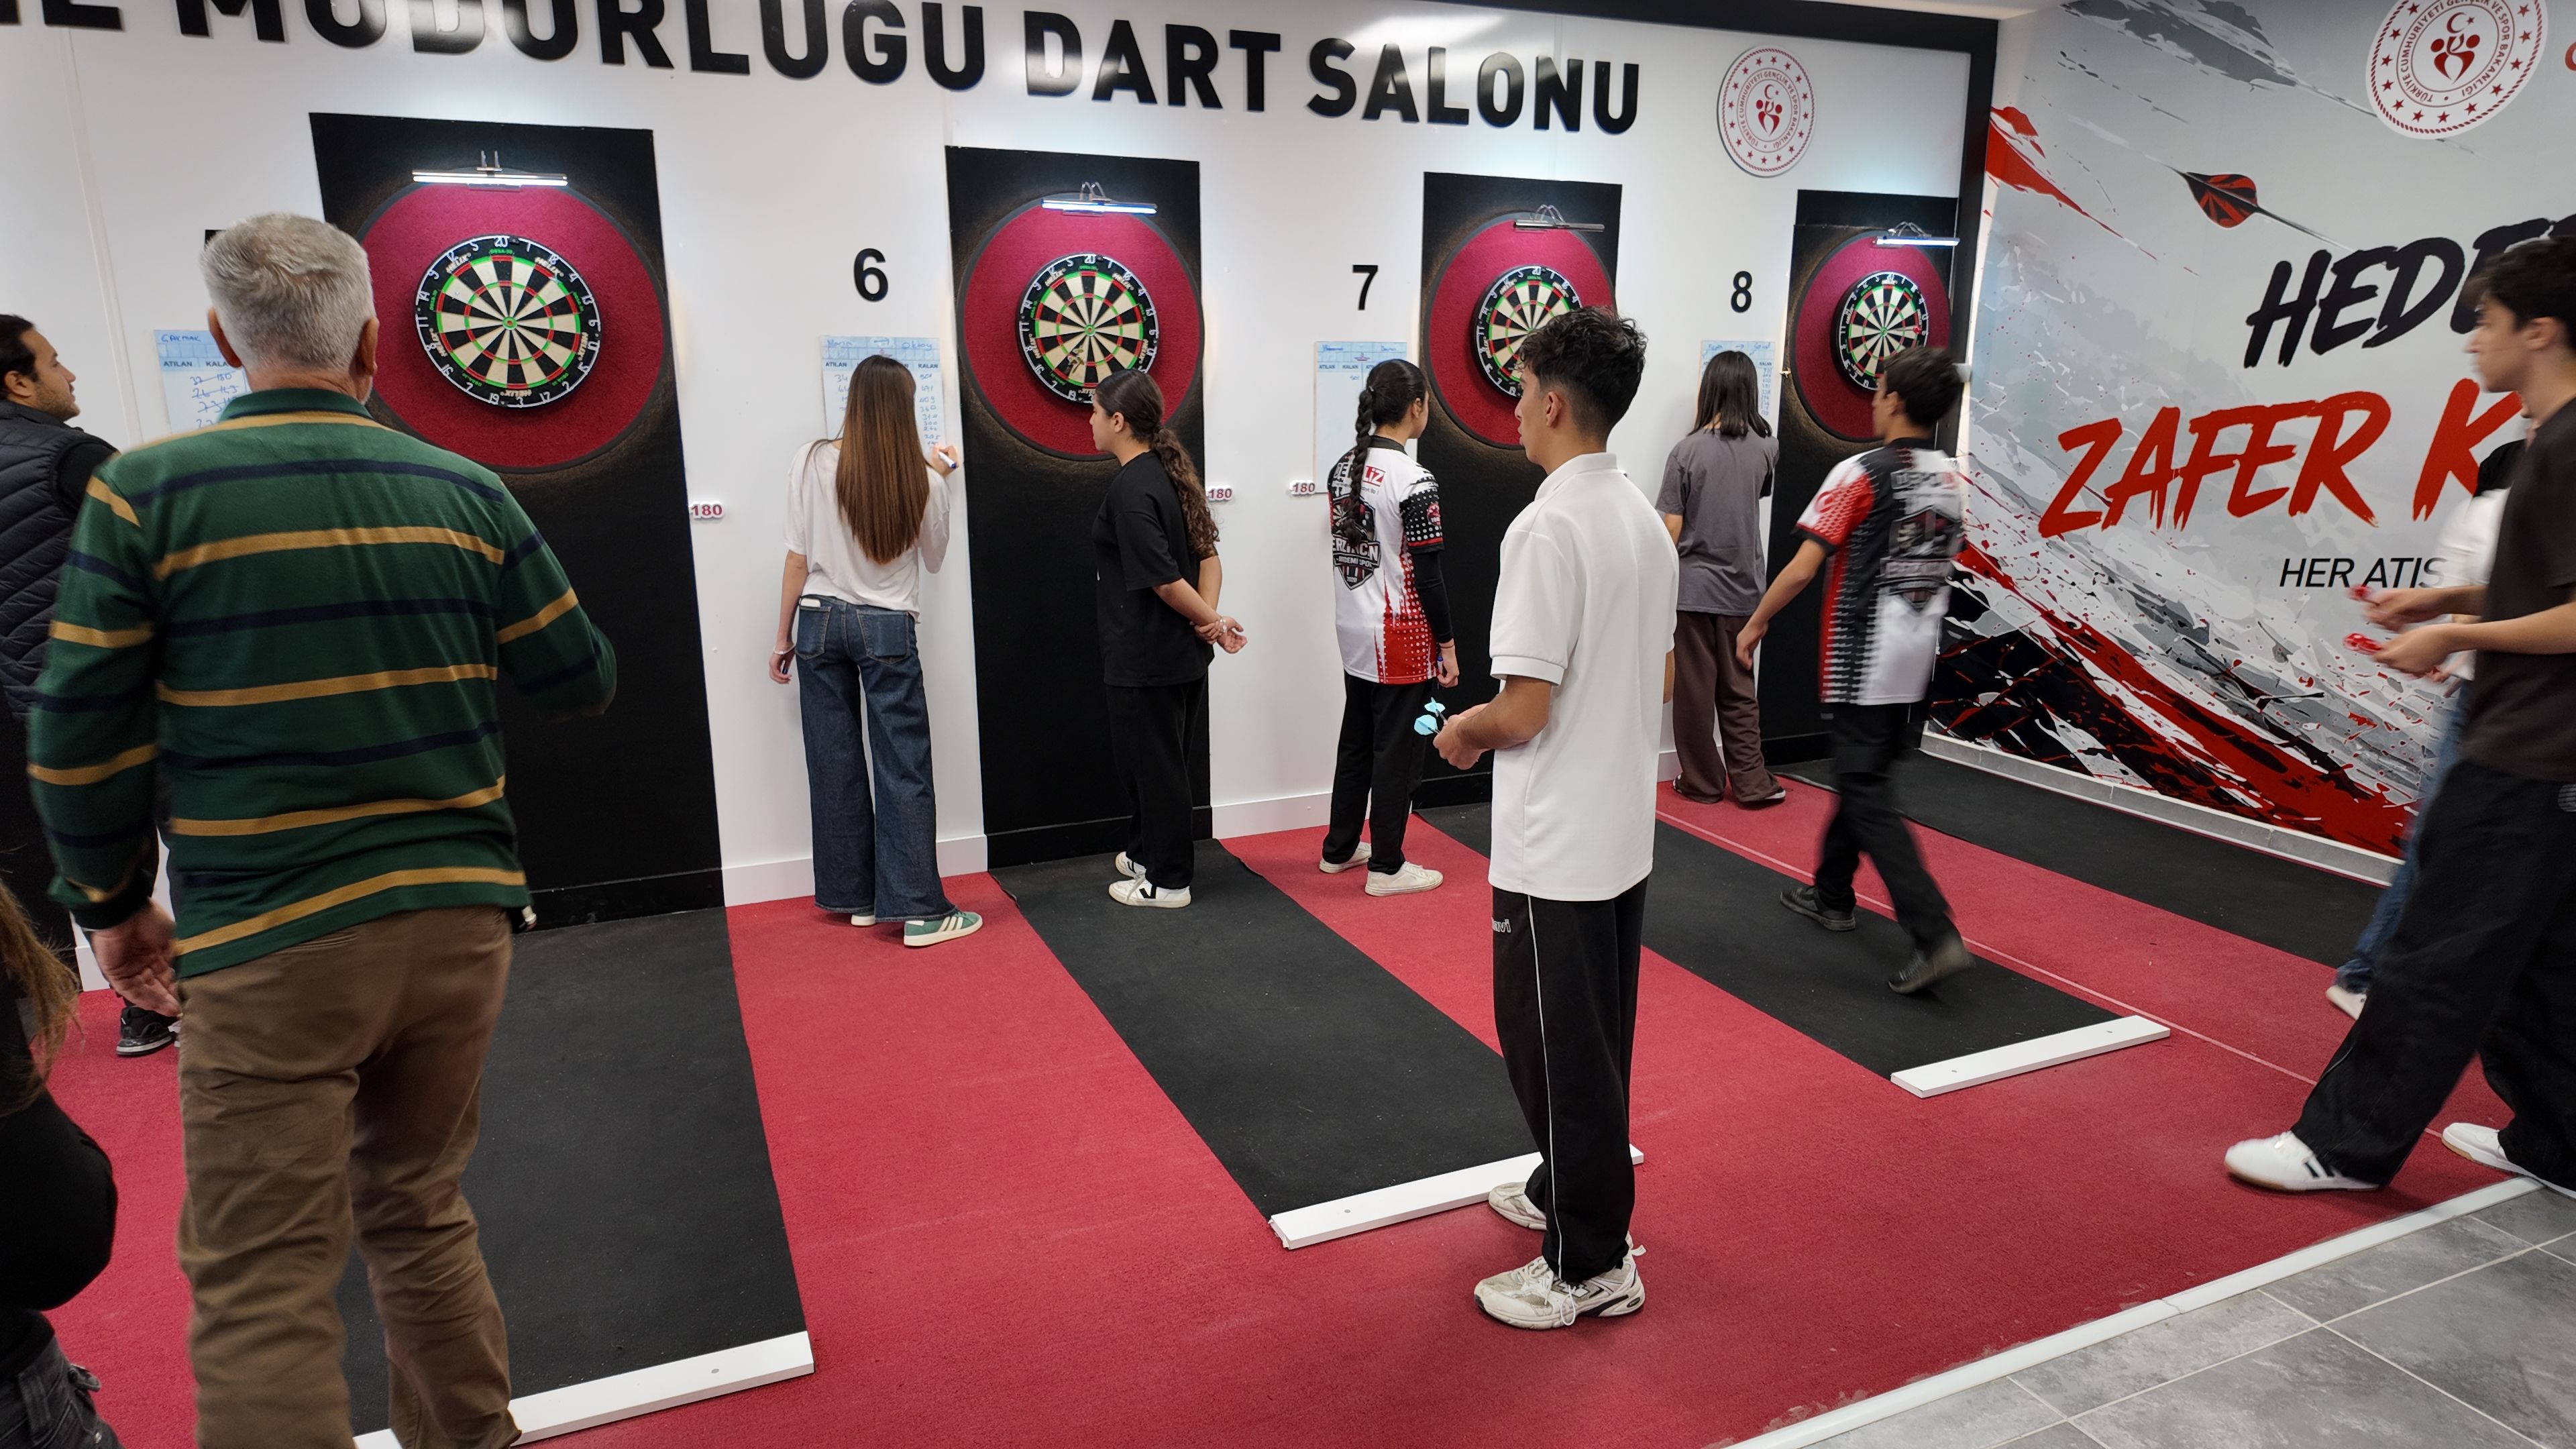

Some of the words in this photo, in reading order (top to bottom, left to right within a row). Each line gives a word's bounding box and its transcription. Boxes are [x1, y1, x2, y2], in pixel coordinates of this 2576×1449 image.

[2491, 1, 2503, 14] VE
[2499, 13, 2510, 41] SPOR
[1024, 10, 1281, 112] DART
[1307, 38, 1640, 134] SALONU
[494, 236, 508, 248] 20
[854, 248, 888, 302] 6
[1352, 265, 1378, 310] 7
[1731, 271, 1752, 313] 8
[2038, 391, 2391, 538] ZAFER
[1208, 488, 1232, 499] 180
[1293, 482, 1316, 493] 180
[692, 504, 722, 516] 180
[2279, 558, 2355, 588] HER
